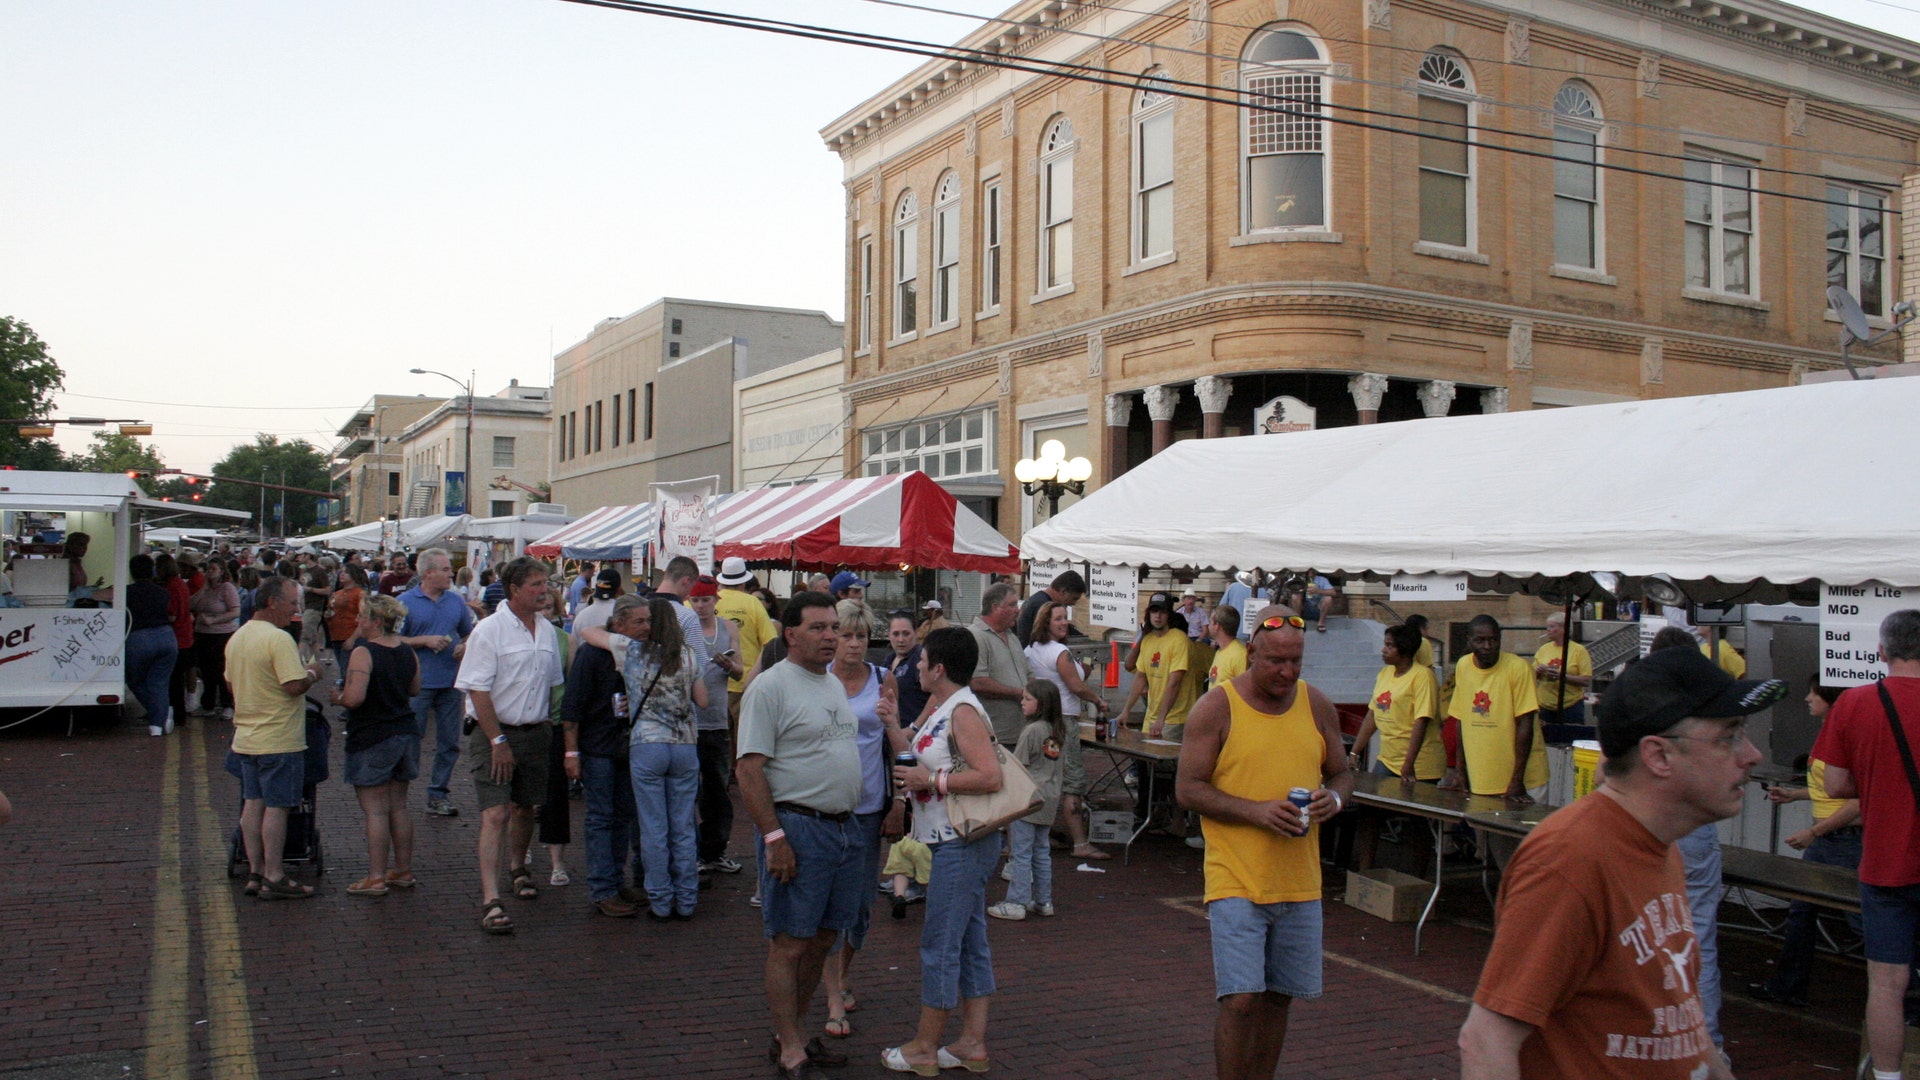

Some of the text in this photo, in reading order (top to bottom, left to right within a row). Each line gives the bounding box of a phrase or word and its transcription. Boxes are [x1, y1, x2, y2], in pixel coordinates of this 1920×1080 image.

[1102, 580, 1115, 588] Light
[1392, 582, 1465, 592] Mikearita 10
[1092, 589, 1114, 597] Michelob
[1114, 591, 1127, 599] Ultra
[1827, 585, 1902, 598] Miller Lite
[1107, 604, 1117, 612] Lite
[1828, 603, 1859, 615] MGD
[1092, 613, 1104, 621] MGD
[53, 611, 107, 668] ALLEY FEST
[1825, 630, 1851, 641] Bud
[1825, 648, 1851, 660] Bud
[1825, 667, 1886, 681] Michelob
